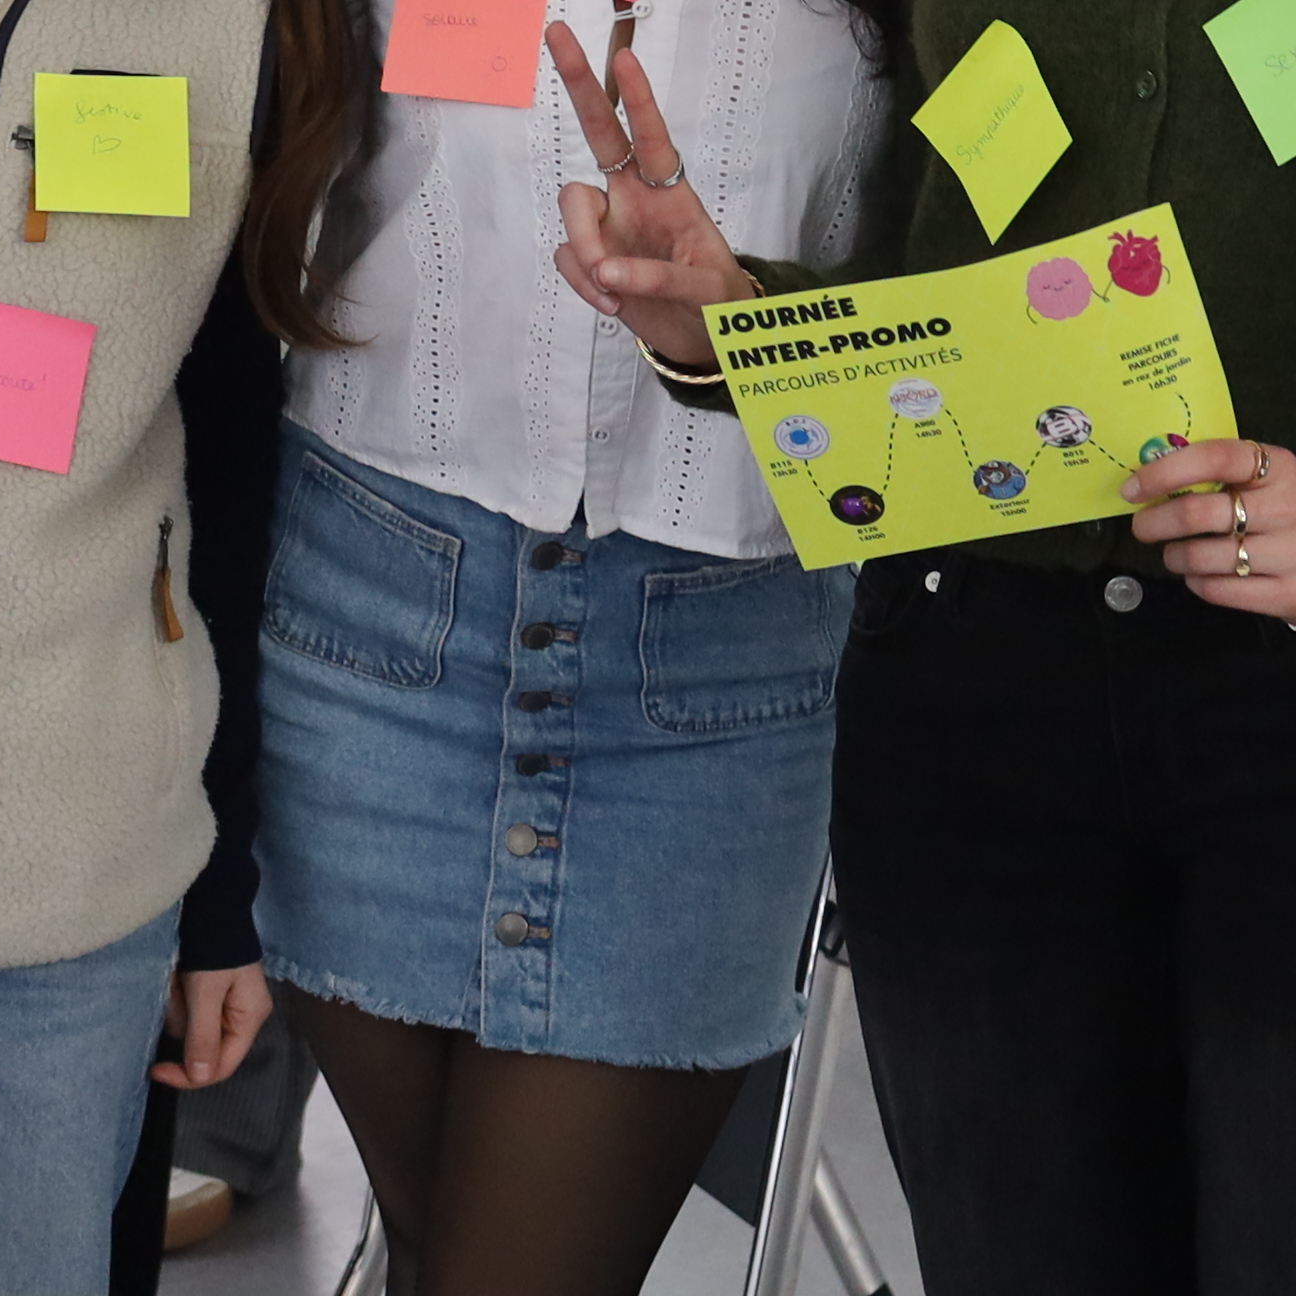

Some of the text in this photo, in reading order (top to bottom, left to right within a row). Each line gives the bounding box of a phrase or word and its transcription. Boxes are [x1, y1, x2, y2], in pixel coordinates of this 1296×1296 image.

[719, 294, 858, 335] JOURNÉE
[727, 317, 952, 370] INTER-PROMO
[1119, 333, 1180, 361] REMISE FICHE
[1128, 347, 1178, 372] PARCOURS
[739, 347, 963, 398] PARCOURS D'ACTIVITÉS
[1148, 374, 1178, 391] 16h30
